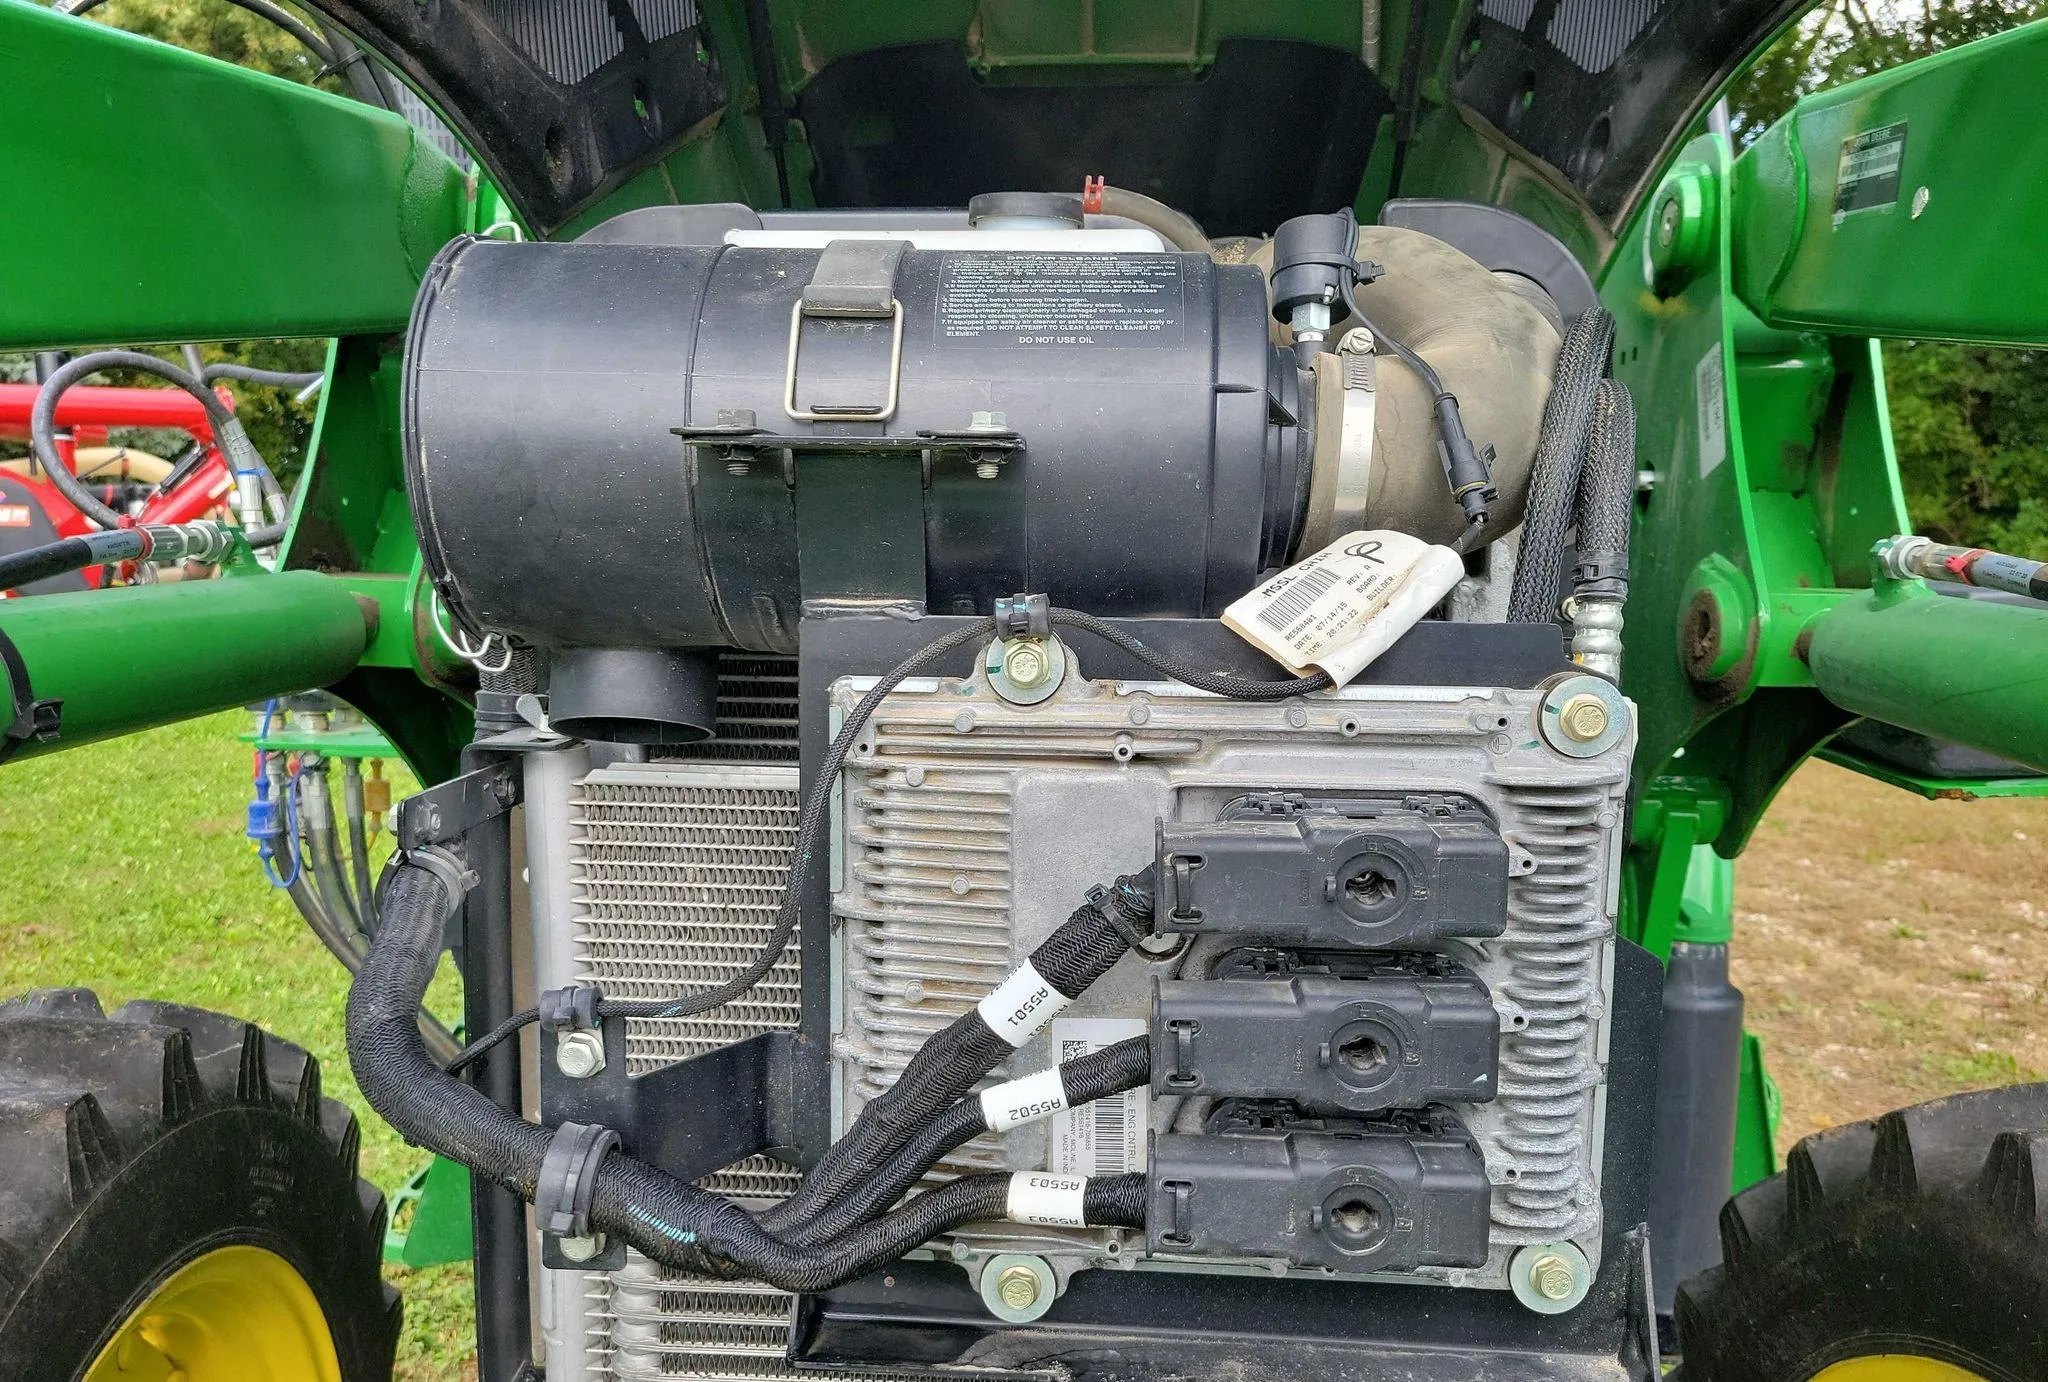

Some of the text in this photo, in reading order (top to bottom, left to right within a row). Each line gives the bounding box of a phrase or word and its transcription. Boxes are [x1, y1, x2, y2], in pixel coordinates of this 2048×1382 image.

[1262, 576, 1298, 597] MSSL
[1347, 571, 1363, 586] REV:
[1356, 573, 1380, 594] BOARD:
[1366, 574, 1397, 602] BUILDER:
[1294, 601, 1348, 650] DATE: 07/14/15
[1305, 608, 1359, 657] TIME: 20:21:22
[1008, 986, 1049, 1026] A5501
[1128, 1088, 1136, 1101] RE
[1009, 1097, 1061, 1121] A5502
[1128, 1109, 1136, 1130] ENG
[1128, 1133, 1136, 1160] CNTRL
[1030, 1177, 1080, 1191] A5503
